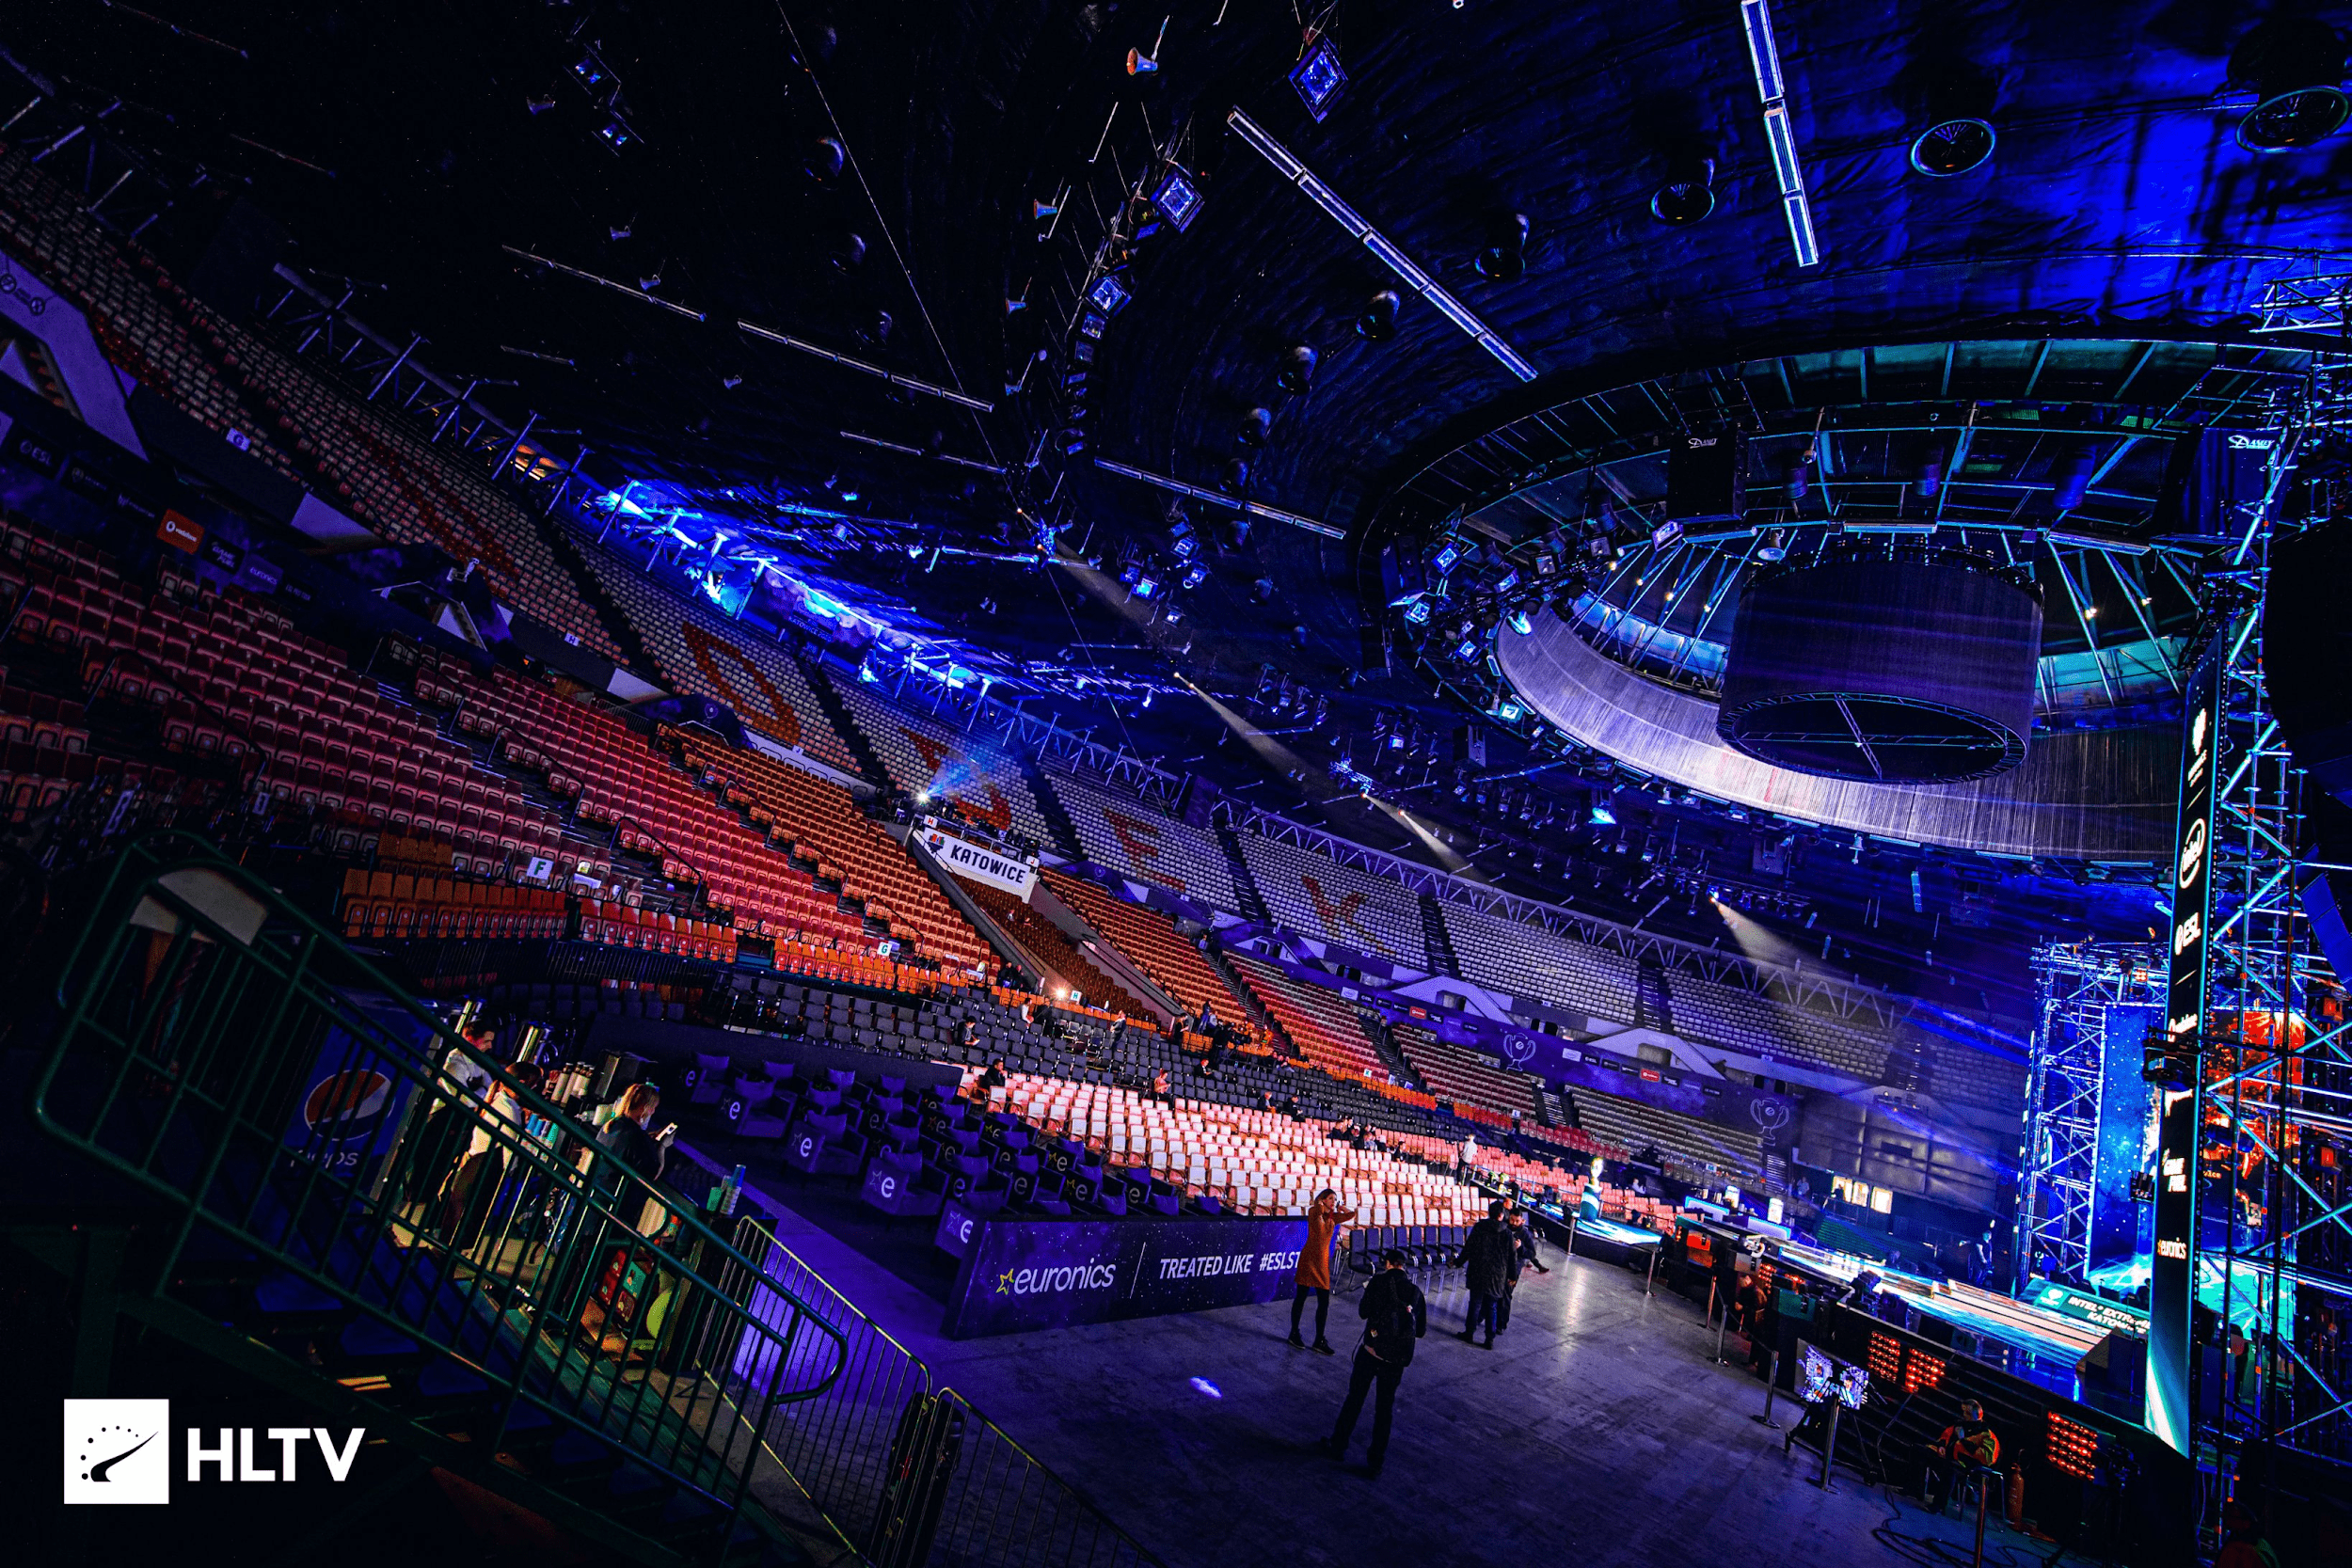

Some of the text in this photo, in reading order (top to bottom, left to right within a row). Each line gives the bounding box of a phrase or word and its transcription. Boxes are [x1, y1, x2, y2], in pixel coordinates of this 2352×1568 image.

[233, 434, 244, 446] G
[31, 446, 51, 467] ESL
[533, 861, 547, 876] F
[950, 845, 1025, 884] KATOWICE
[2183, 912, 2201, 947] ESL
[729, 1101, 740, 1120] e
[869, 1113, 880, 1130] e
[800, 1137, 812, 1157] e
[945, 1146, 955, 1163] e
[1057, 1156, 1068, 1172] e
[882, 1177, 895, 1198] e
[954, 1178, 965, 1197] e
[1014, 1176, 1028, 1196] e
[1074, 1183, 1088, 1201] e
[1128, 1187, 1140, 1205] e
[1159, 1251, 1301, 1279] TREATED LIKE #ESLST
[1013, 1258, 1116, 1294] euronics
